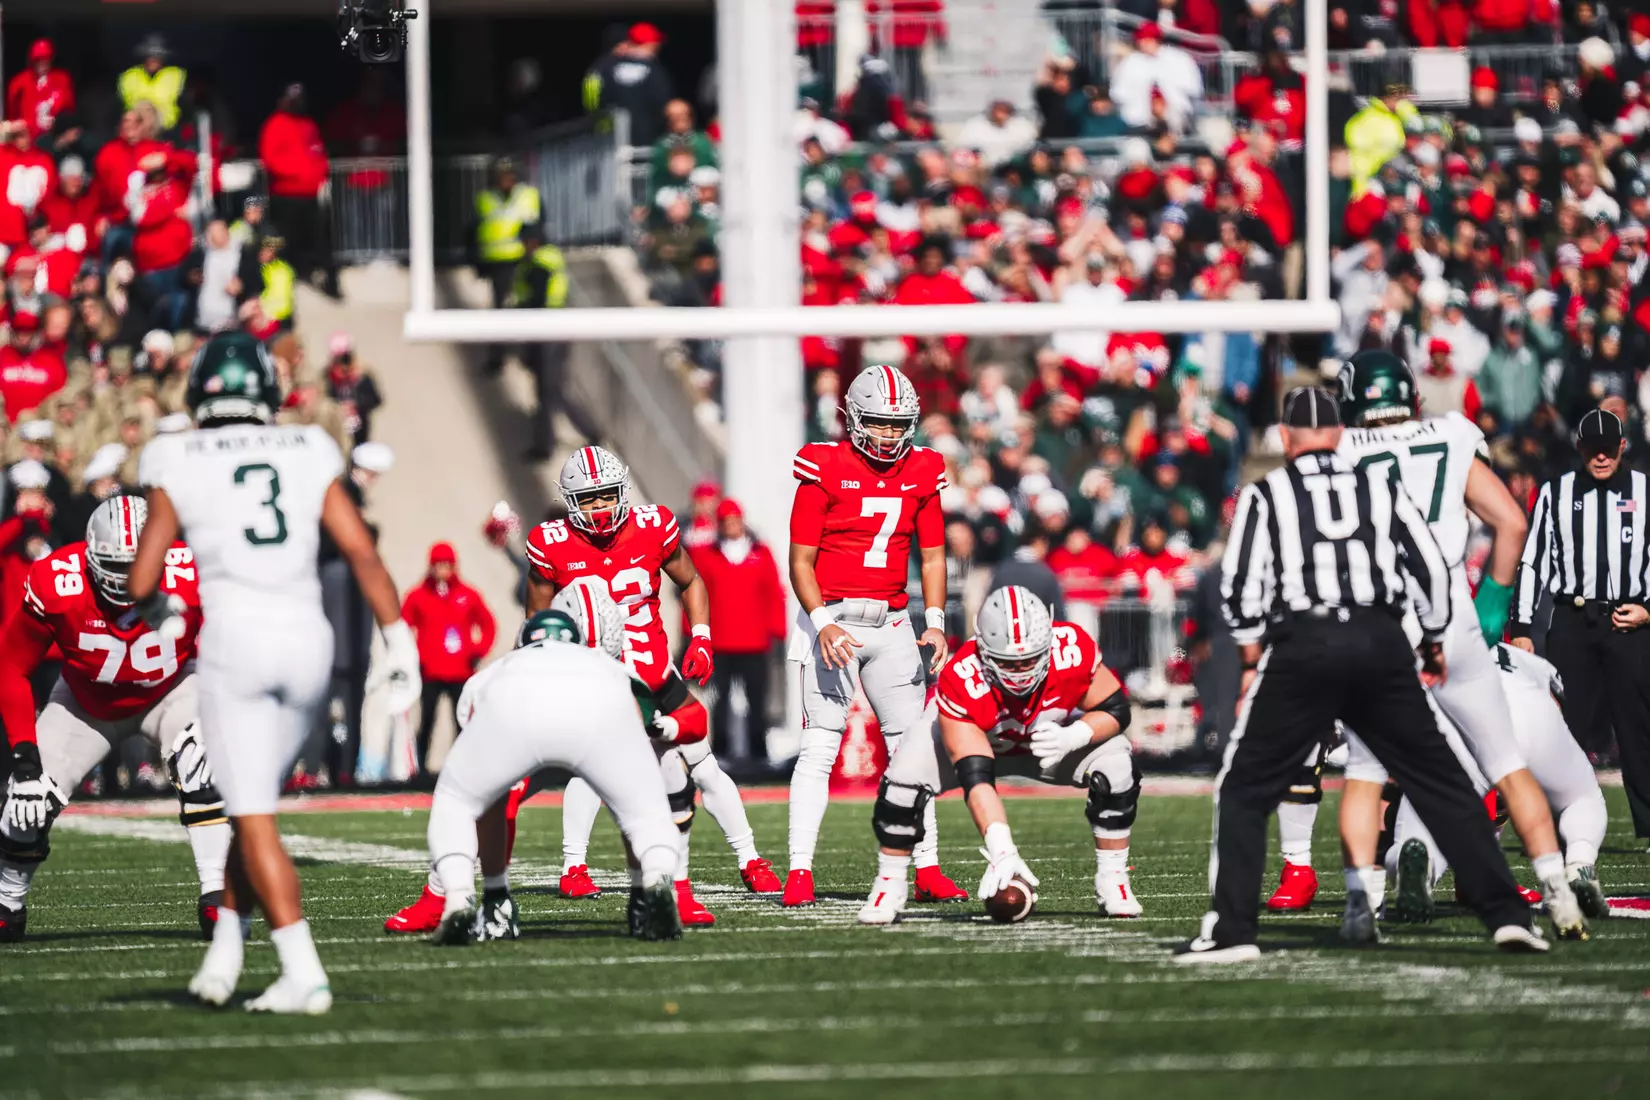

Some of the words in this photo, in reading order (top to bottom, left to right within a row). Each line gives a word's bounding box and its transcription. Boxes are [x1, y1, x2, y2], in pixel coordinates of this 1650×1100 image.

[233, 463, 288, 545] 3
[1302, 473, 1360, 540] U
[1573, 500, 1583, 511] S
[859, 496, 902, 568] 7
[1621, 526, 1633, 543] C
[51, 553, 84, 597] 79
[164, 547, 195, 589] 79
[78, 630, 179, 688] 79
[1051, 625, 1083, 671] 53
[952, 653, 991, 700] 53
